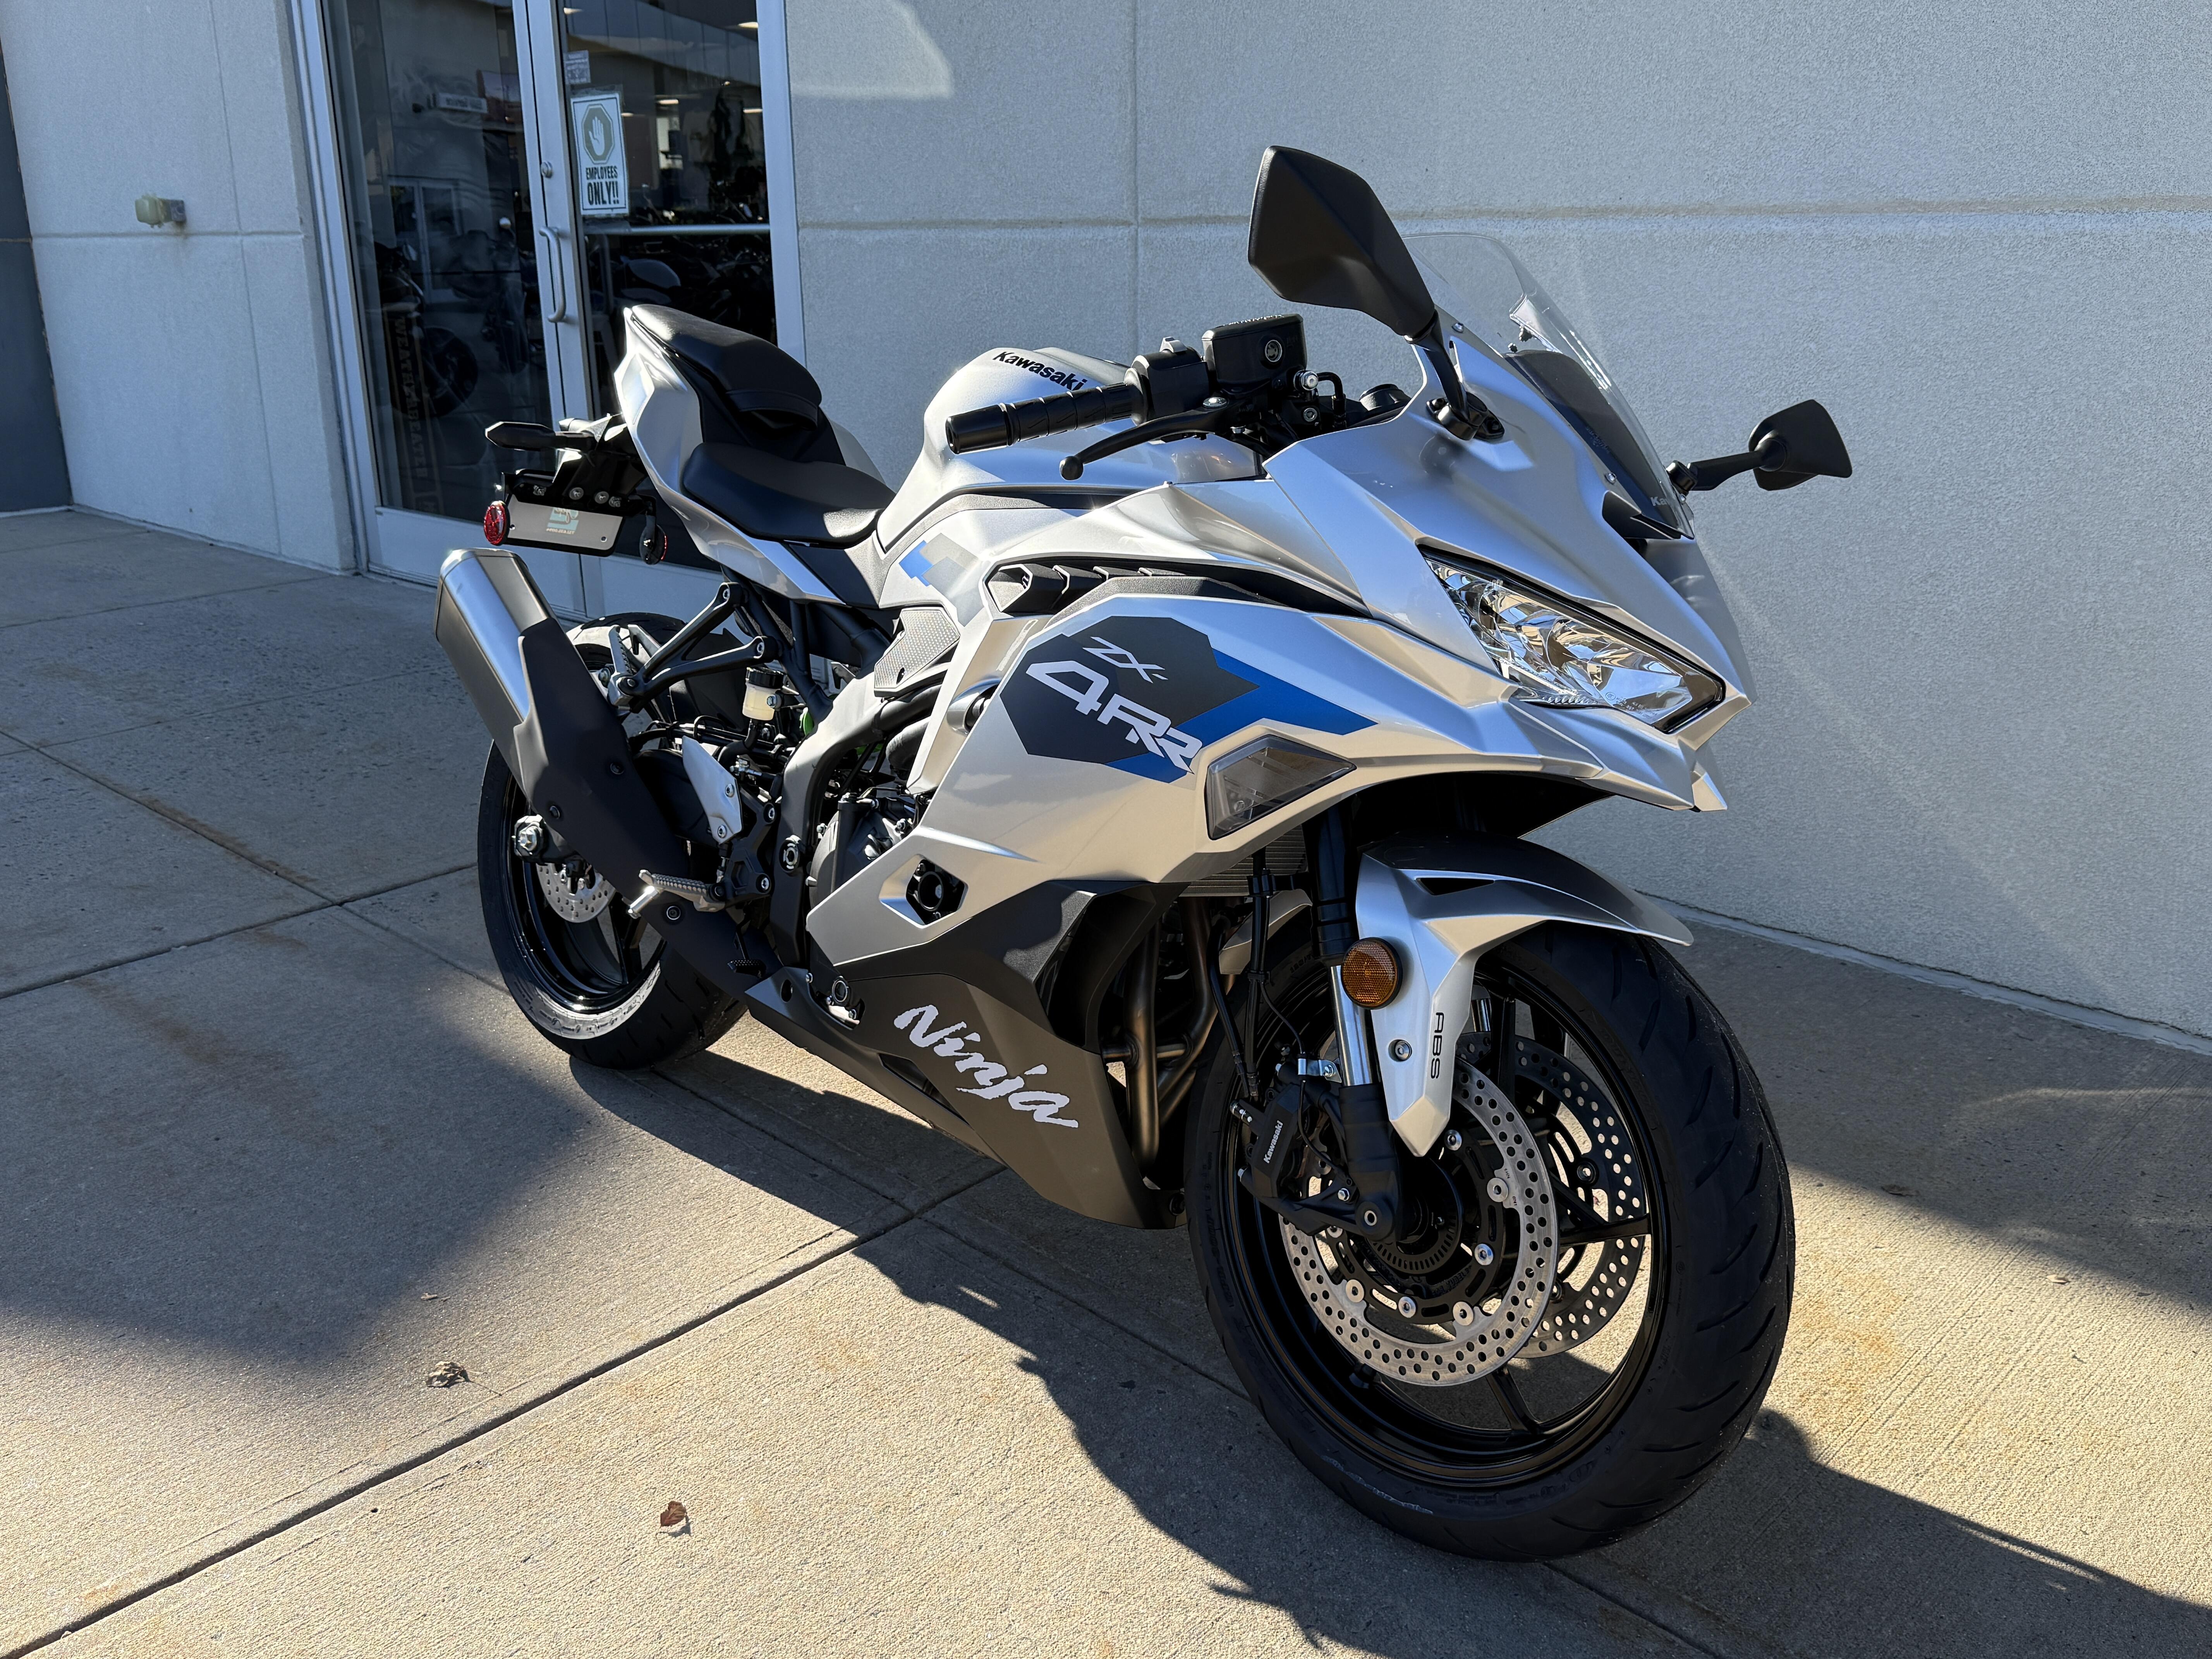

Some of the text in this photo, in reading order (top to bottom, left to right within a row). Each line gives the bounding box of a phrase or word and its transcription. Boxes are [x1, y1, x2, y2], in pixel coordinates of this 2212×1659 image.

[586, 166, 618, 180] EMPLOYEES
[587, 181, 620, 205] ONLY!!
[992, 352, 1088, 391] Kawasaki
[1025, 660, 1203, 775] 4RR
[893, 1005, 1079, 1128] Ninja
[1430, 1012, 1444, 1079] ABS
[1263, 1120, 1283, 1164] Kawasaki
